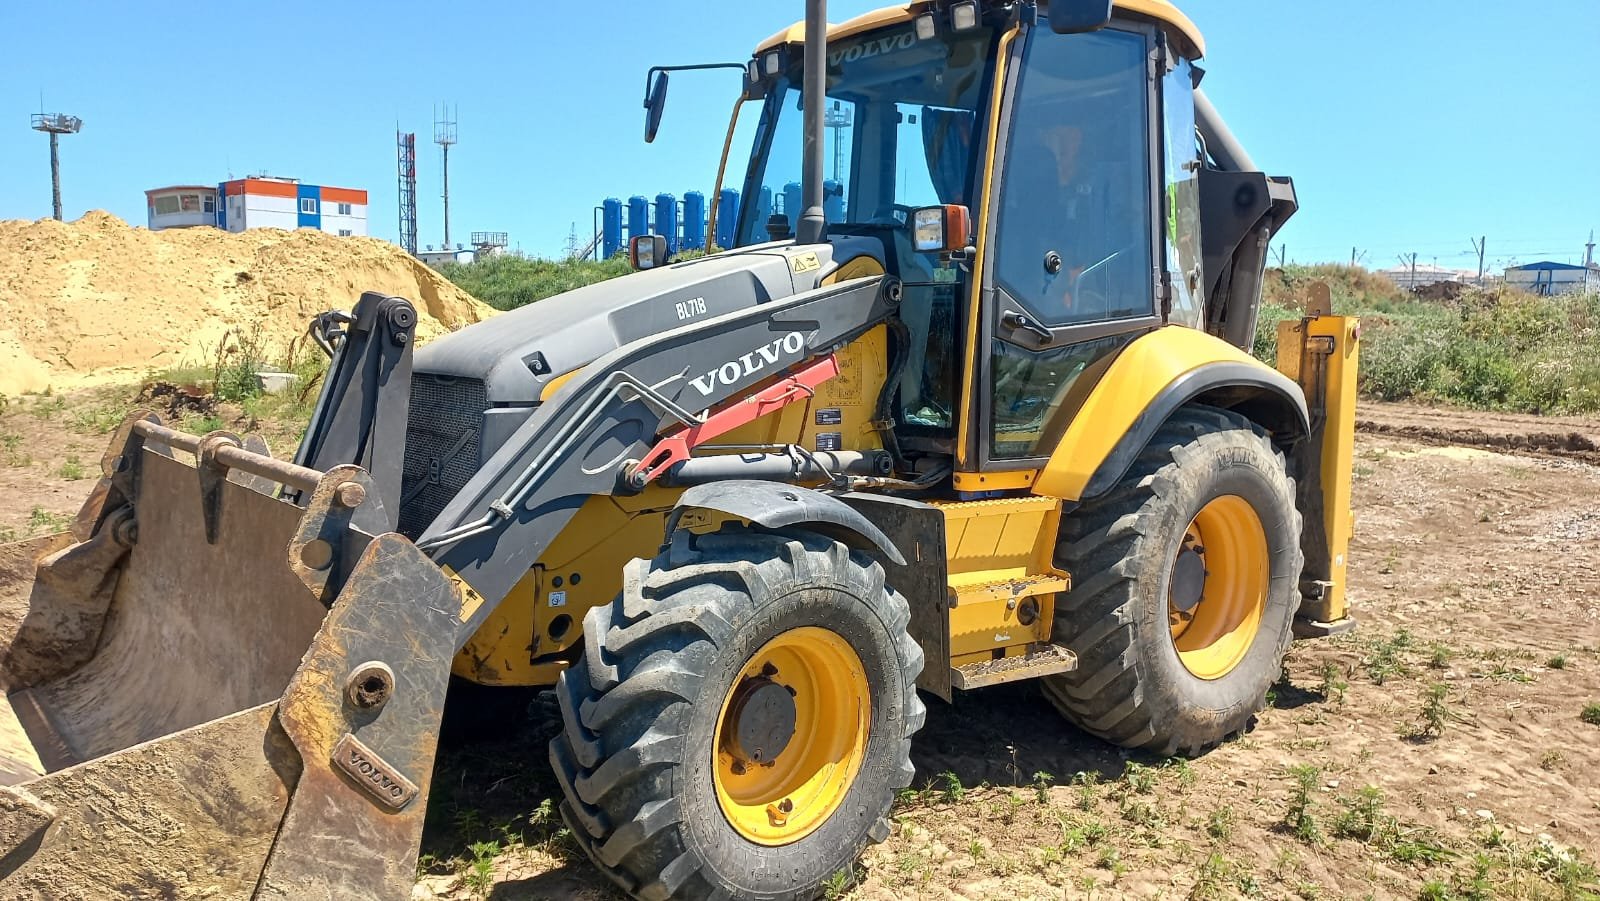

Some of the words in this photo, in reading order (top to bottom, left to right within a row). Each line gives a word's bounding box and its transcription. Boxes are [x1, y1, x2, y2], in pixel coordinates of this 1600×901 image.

[829, 32, 916, 66] VOLVO
[675, 297, 707, 320] BL71B
[688, 331, 804, 396] VOLVO
[349, 750, 403, 799] VOLVO
